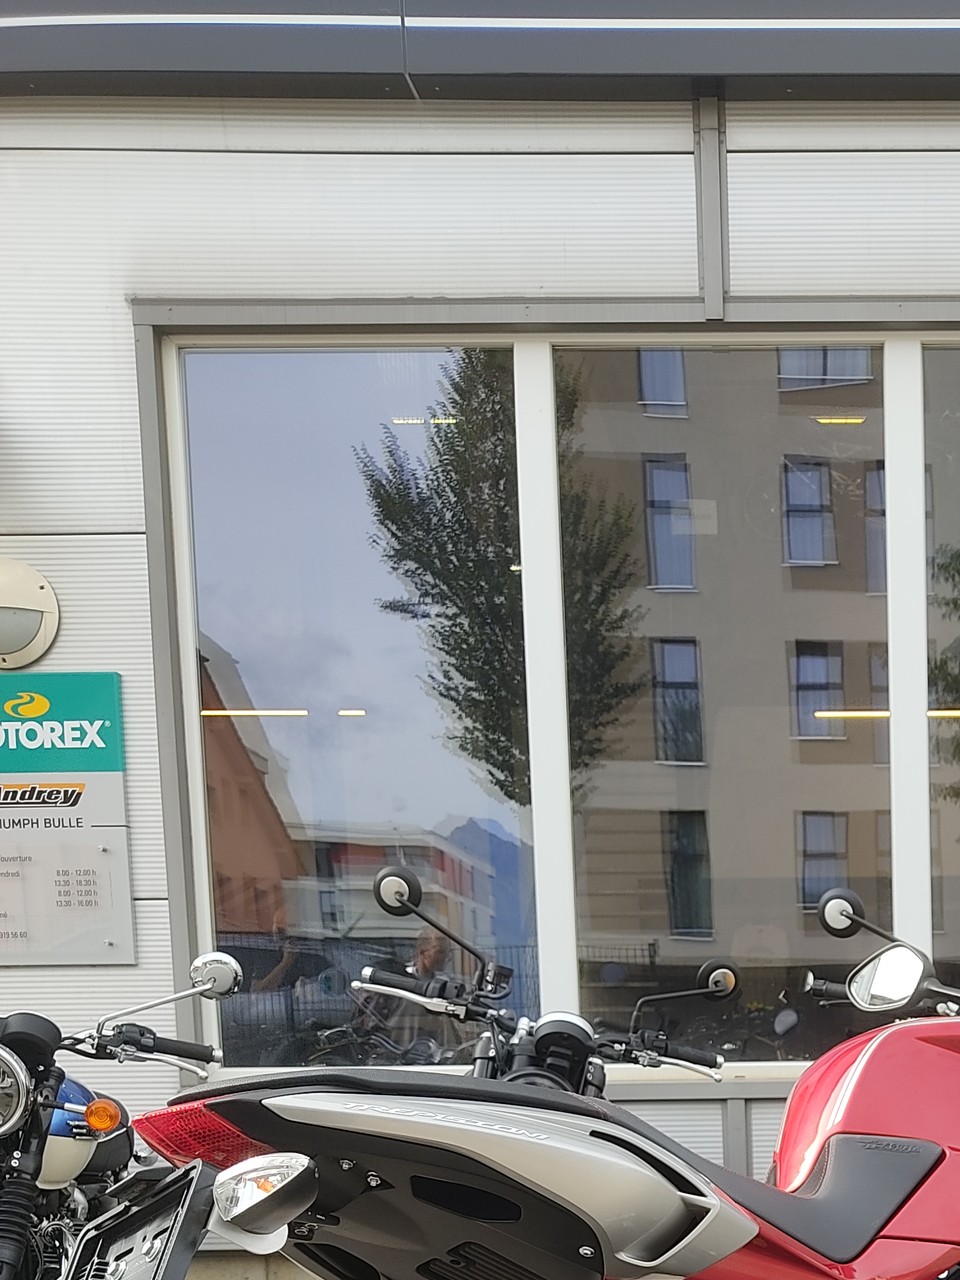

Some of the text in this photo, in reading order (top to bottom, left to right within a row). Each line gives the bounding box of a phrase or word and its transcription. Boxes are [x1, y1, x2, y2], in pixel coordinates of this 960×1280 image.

[0, 720, 106, 750] TOREX
[0, 786, 78, 804] ndrey
[44, 817, 84, 828] BULLE
[0, 869, 20, 877] ndredi
[11, 931, 18, 939] 56
